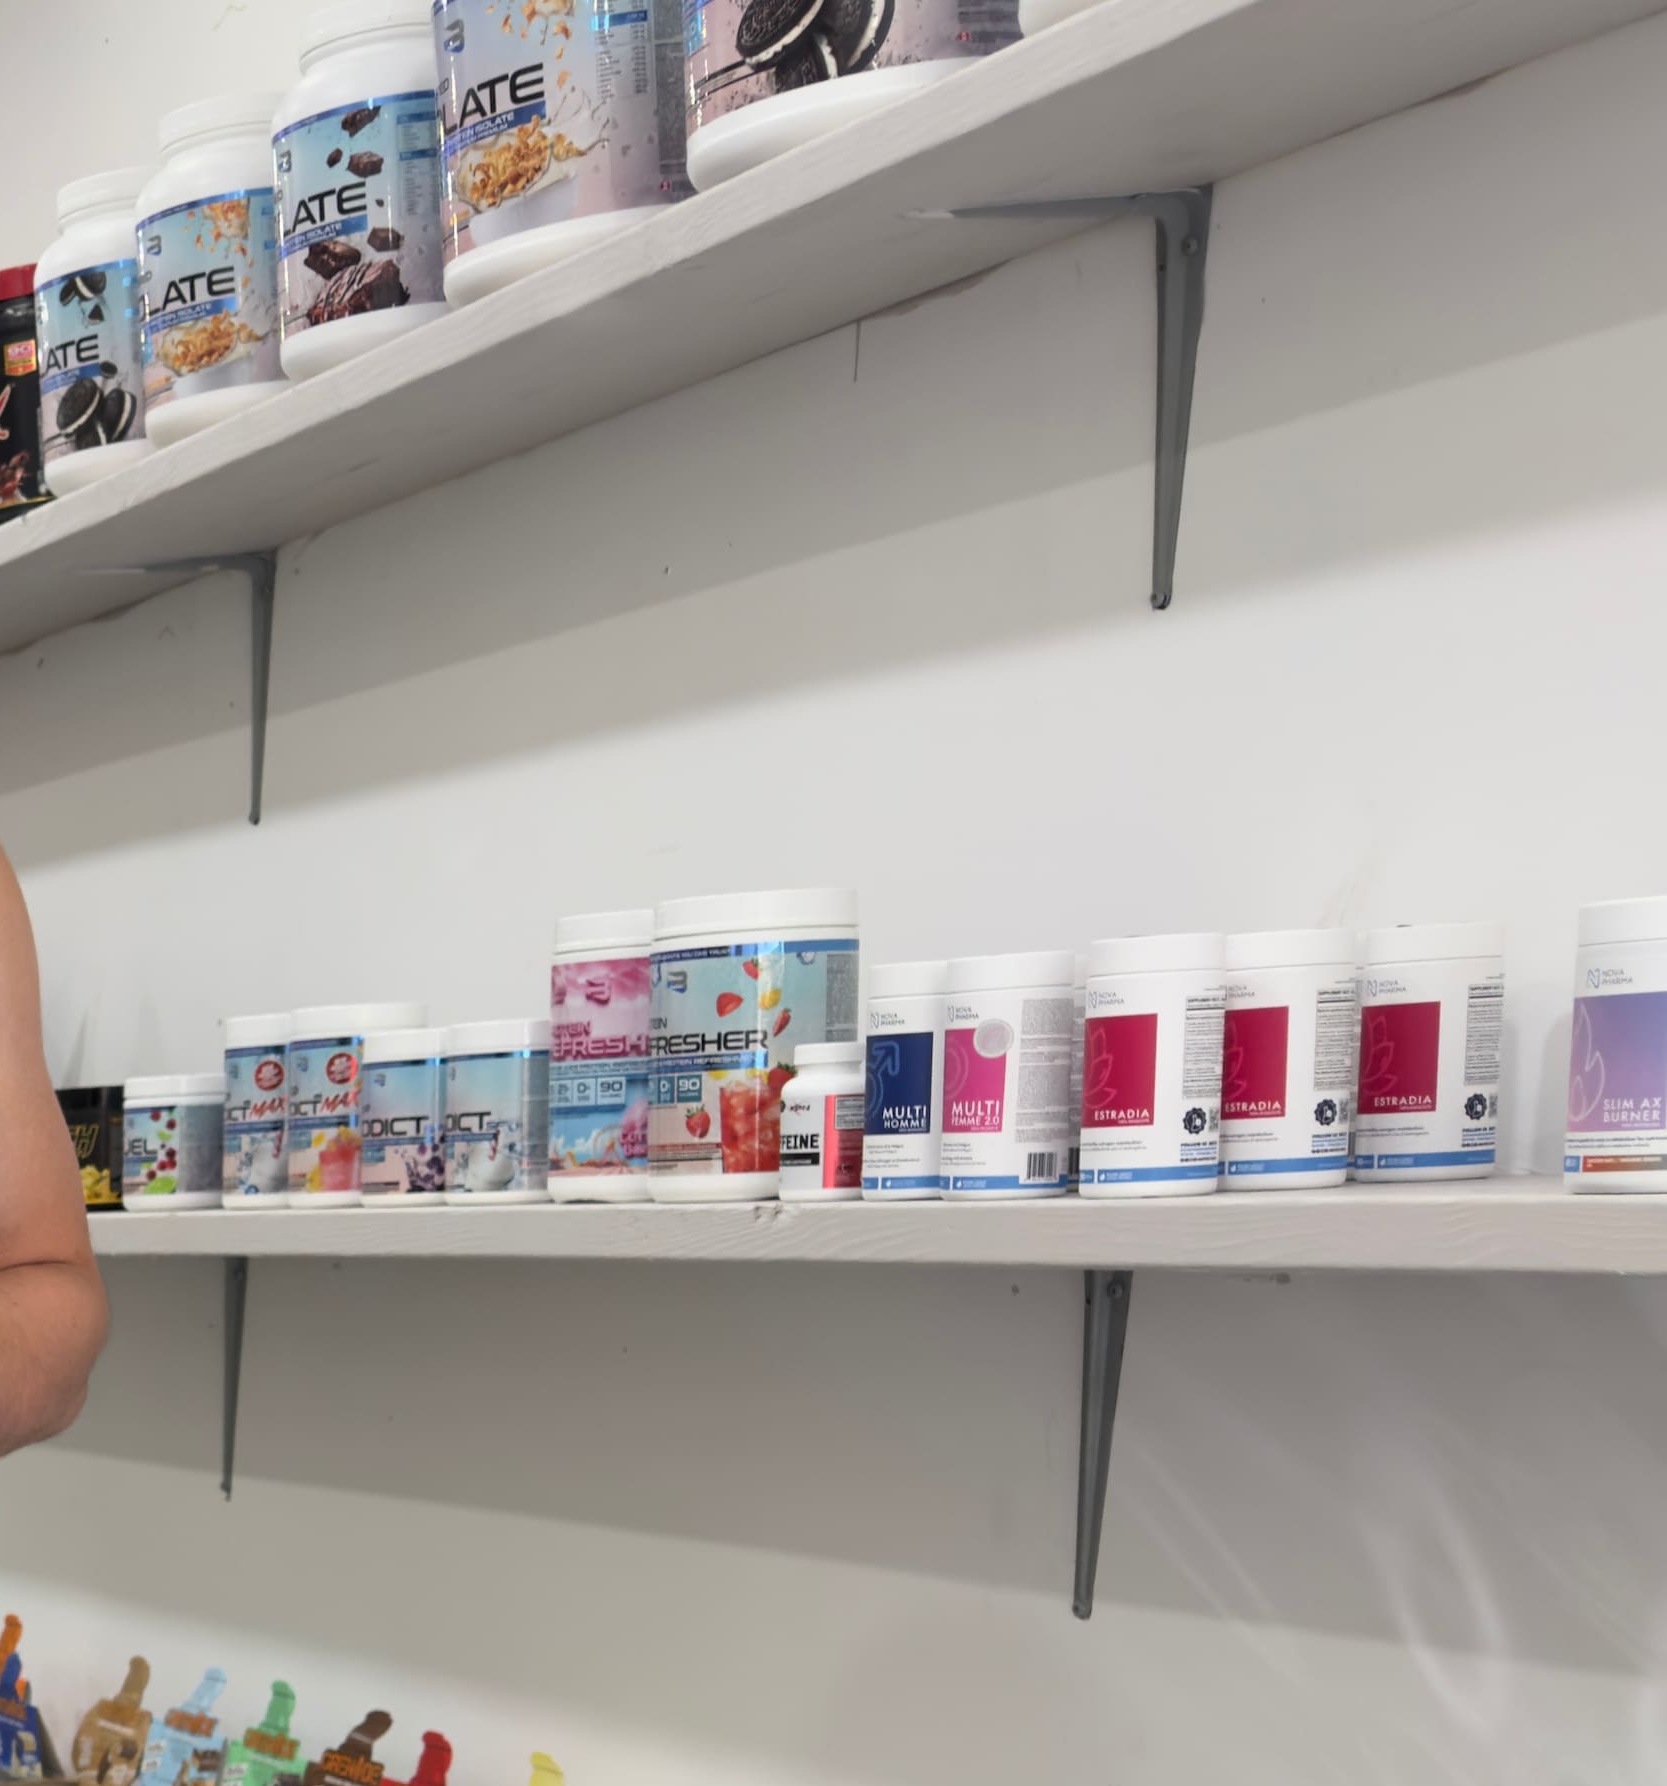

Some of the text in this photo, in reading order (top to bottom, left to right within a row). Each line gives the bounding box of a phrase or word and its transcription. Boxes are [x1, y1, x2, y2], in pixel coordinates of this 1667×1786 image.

[678, 1078, 700, 1090] 90
[1225, 1100, 1281, 1113] ESTRADIA
[1374, 1094, 1432, 1107] ESTRADIA
[1603, 1097, 1662, 1111] SLIM AX
[883, 1105, 927, 1120] MULTI
[952, 1100, 1000, 1116] MULTI
[984, 1116, 1000, 1126] 2.0
[1094, 1109, 1150, 1121] ESTRADIA
[1603, 1111, 1661, 1123] BURNER
[884, 1119, 927, 1129] HOMME
